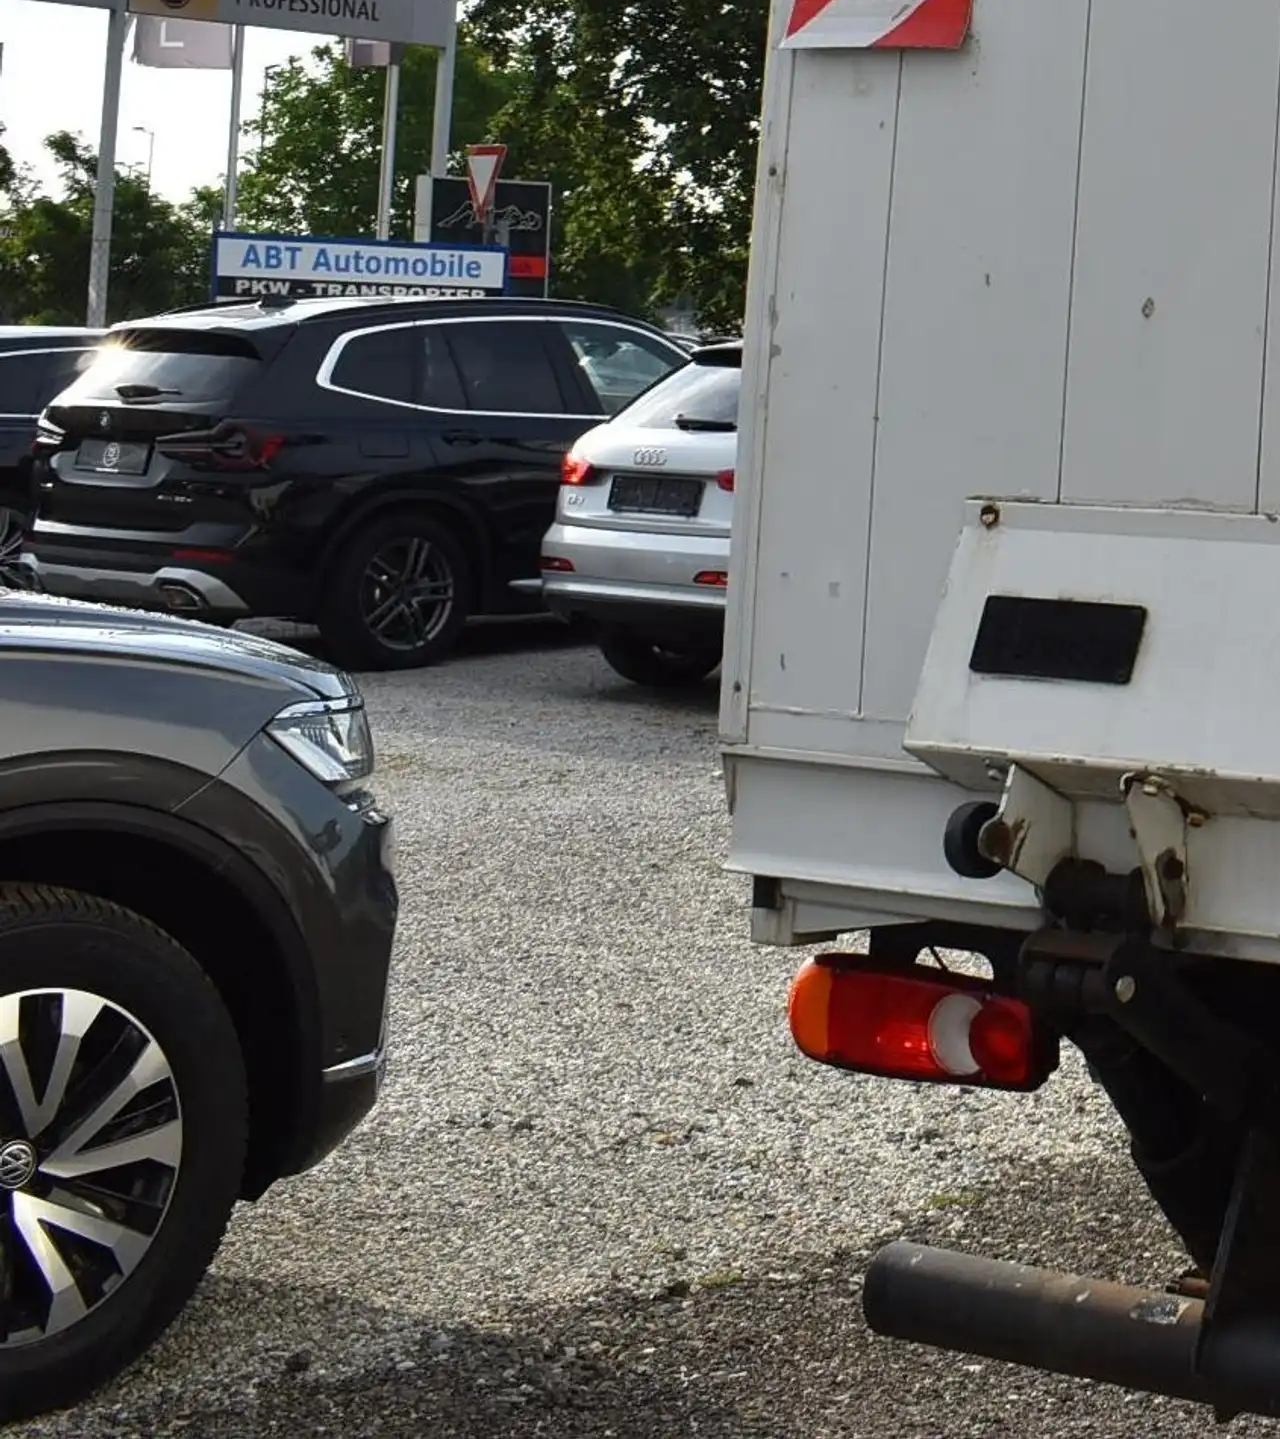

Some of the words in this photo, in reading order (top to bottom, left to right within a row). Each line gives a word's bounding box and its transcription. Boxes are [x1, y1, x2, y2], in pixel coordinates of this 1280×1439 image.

[241, 244, 302, 270] ABT
[312, 247, 482, 278] Automobile
[235, 279, 291, 295] PKW
